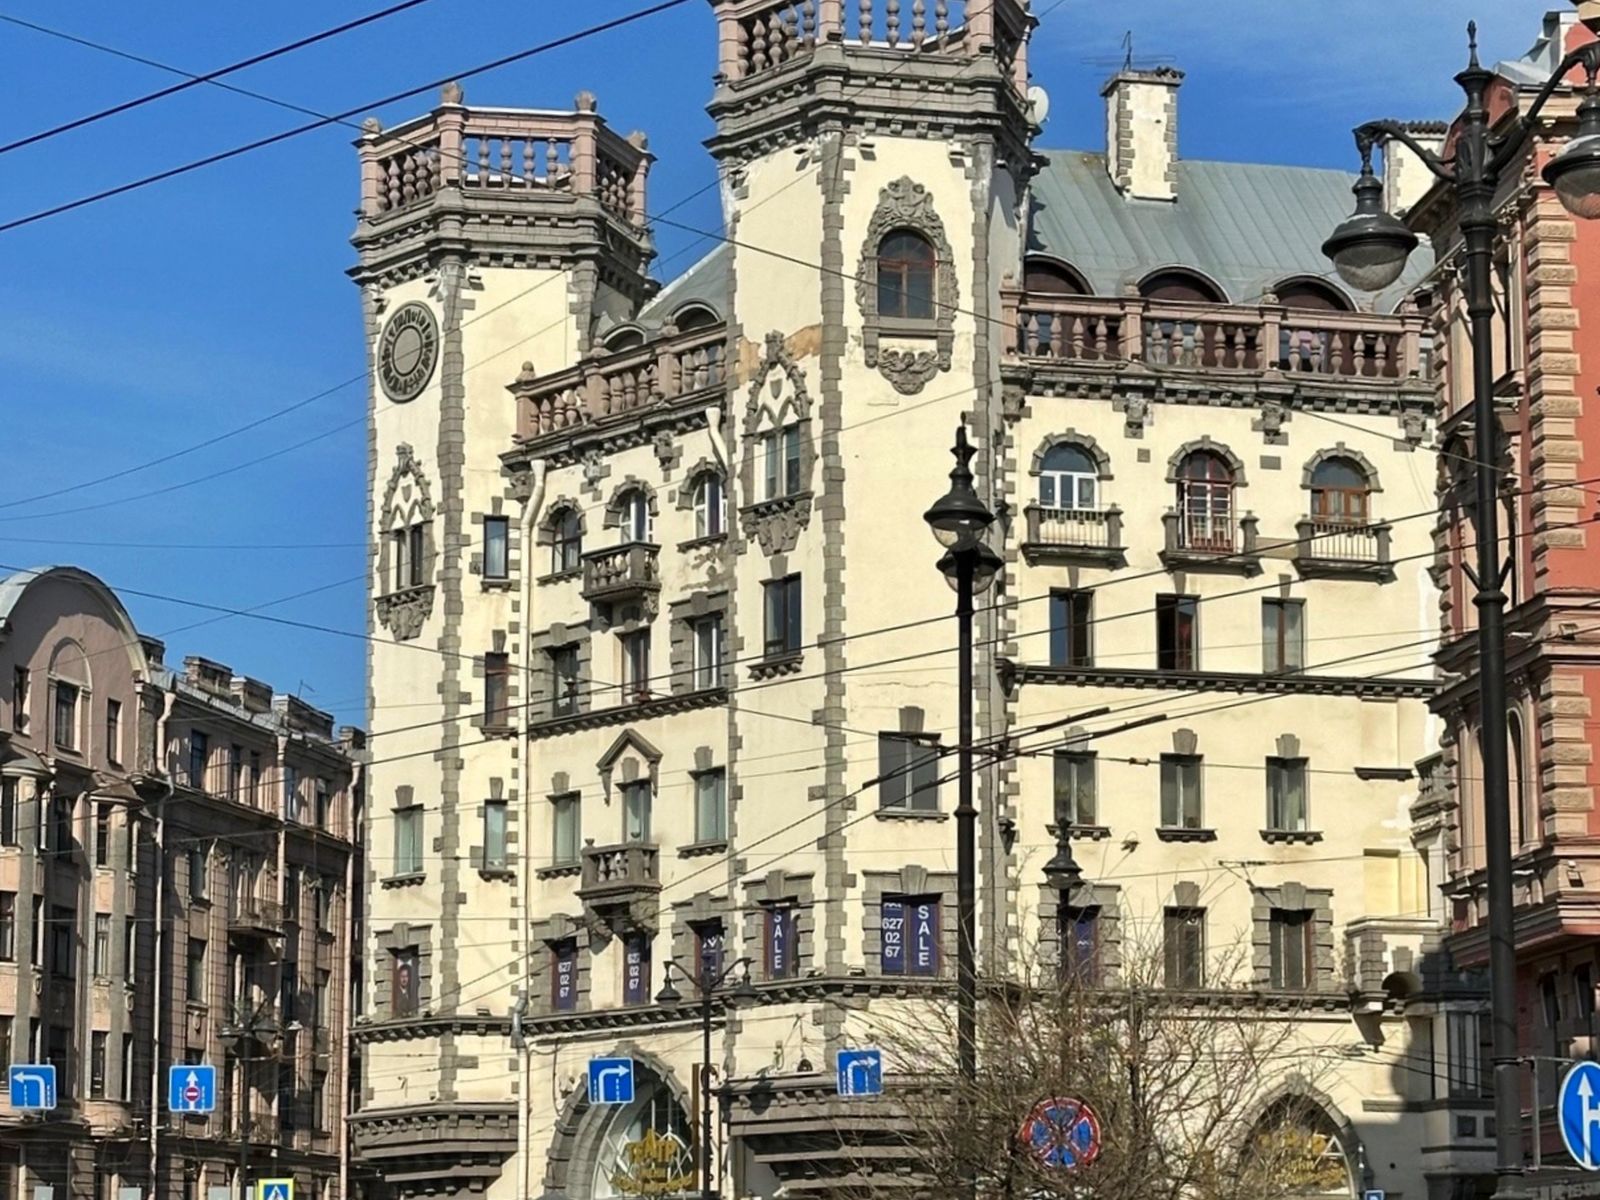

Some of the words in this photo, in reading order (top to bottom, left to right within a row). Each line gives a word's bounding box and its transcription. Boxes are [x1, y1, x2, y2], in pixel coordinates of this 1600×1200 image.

[882, 918, 904, 930] 627
[773, 910, 783, 969] SALE
[885, 932, 900, 944] 02
[918, 905, 931, 966] SALE
[885, 946, 901, 957] 67
[560, 975, 570, 985] 02
